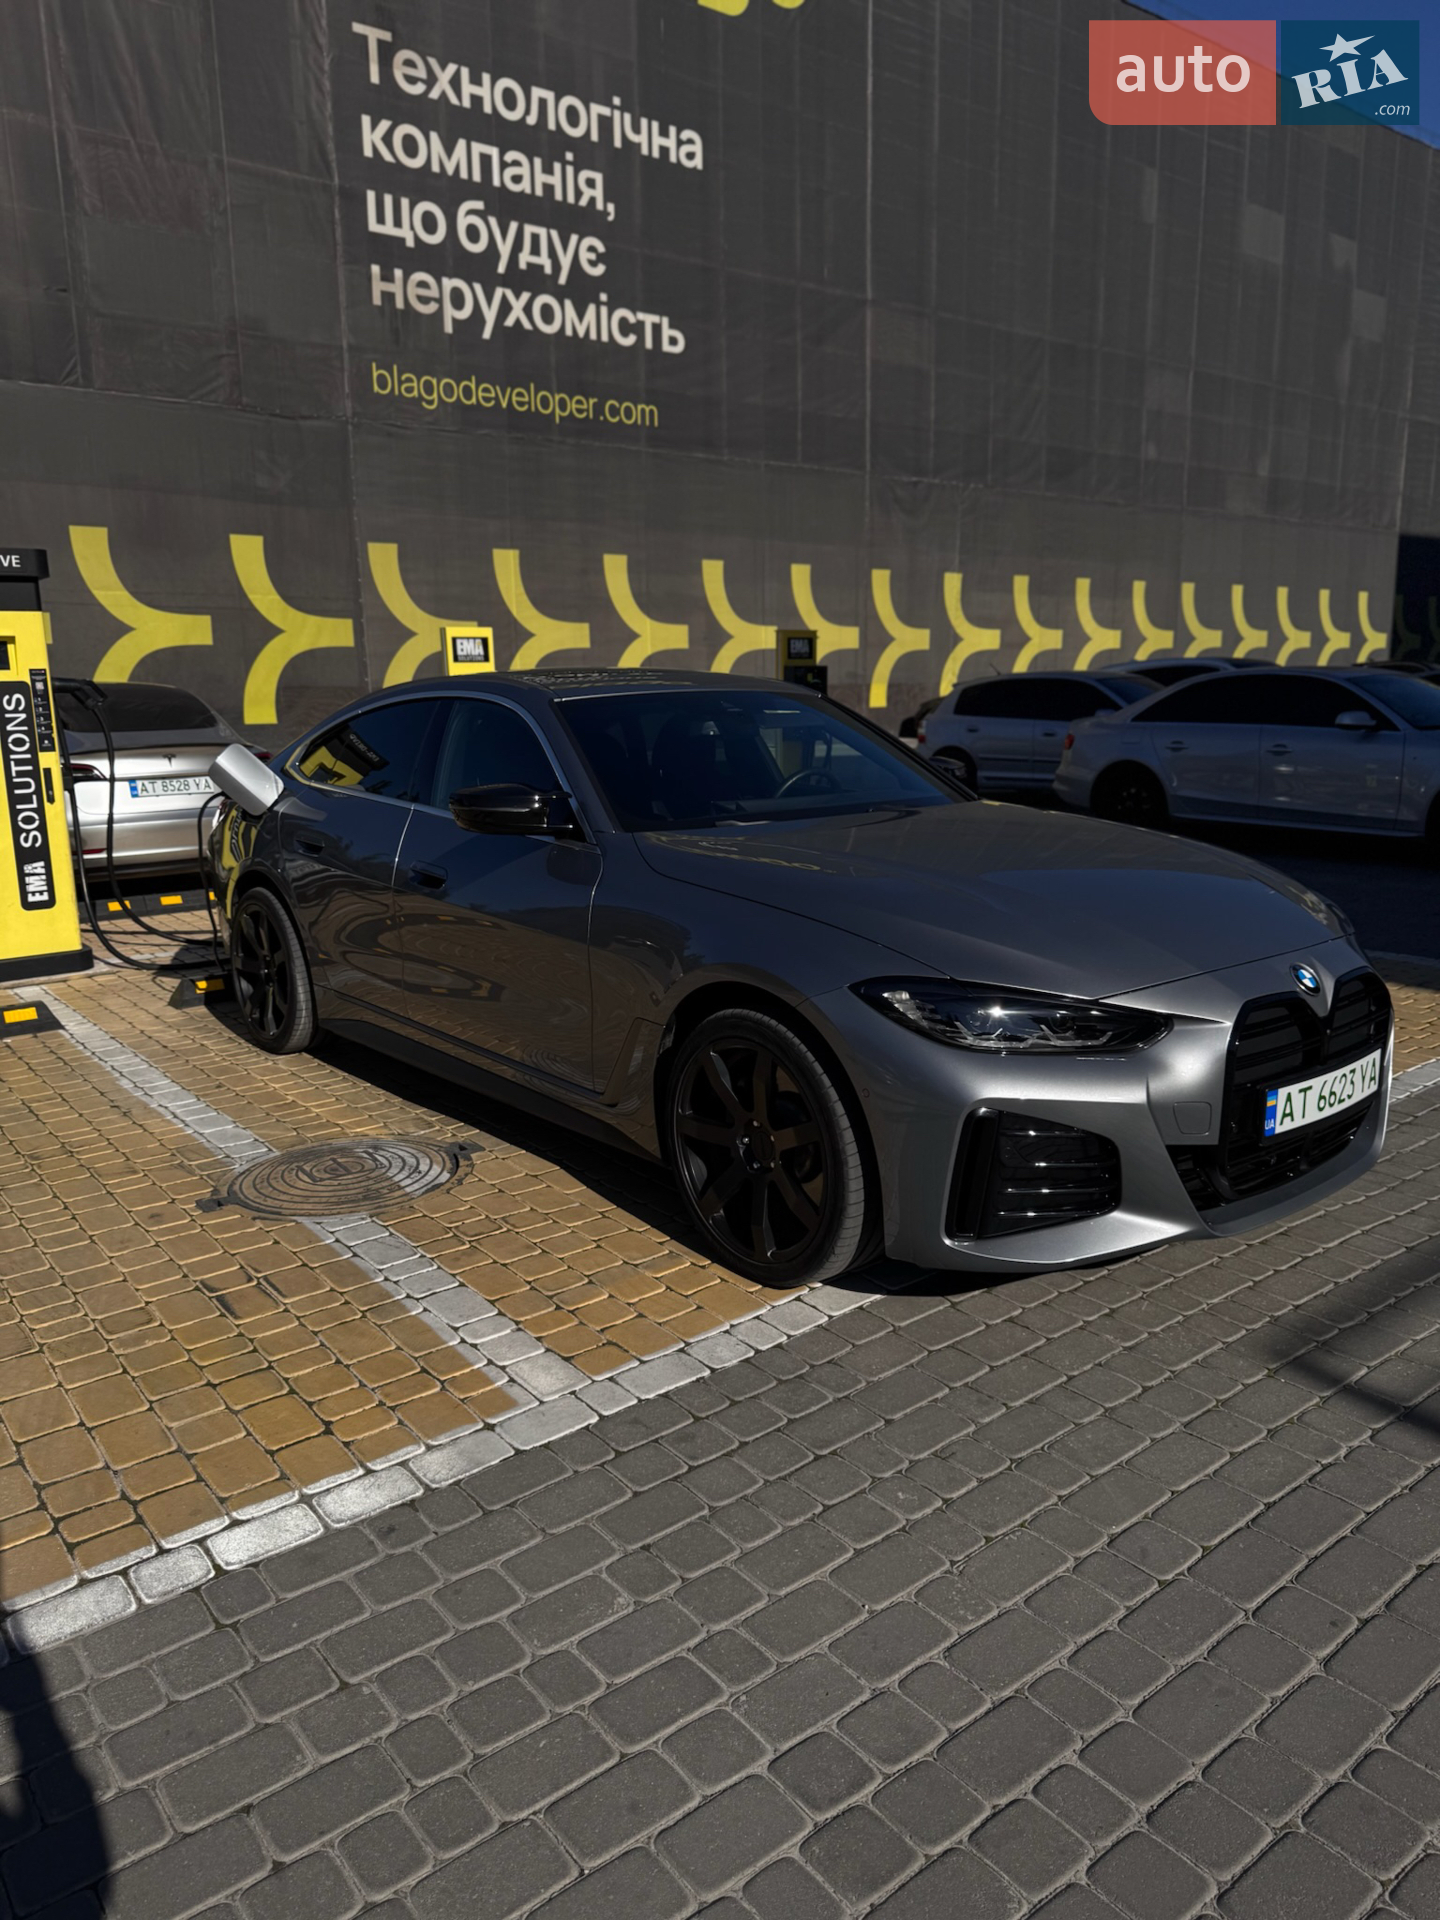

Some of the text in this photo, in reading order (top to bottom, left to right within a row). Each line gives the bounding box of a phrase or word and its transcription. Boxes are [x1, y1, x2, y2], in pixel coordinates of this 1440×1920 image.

[351, 21, 704, 170] Технологічна
[361, 114, 616, 222] компанія,
[366, 189, 607, 286] що будує
[370, 263, 686, 355] нерухомість
[371, 362, 659, 428] blagodeveloper.com
[456, 638, 485, 656] EMA
[3, 693, 42, 848] SOLUTIONS
[141, 781, 157, 795] AT
[161, 779, 191, 793] 8528
[23, 861, 49, 902] EMA
[1265, 1119, 1275, 1129] UA
[1279, 1057, 1377, 1126] AT 6623 YA
